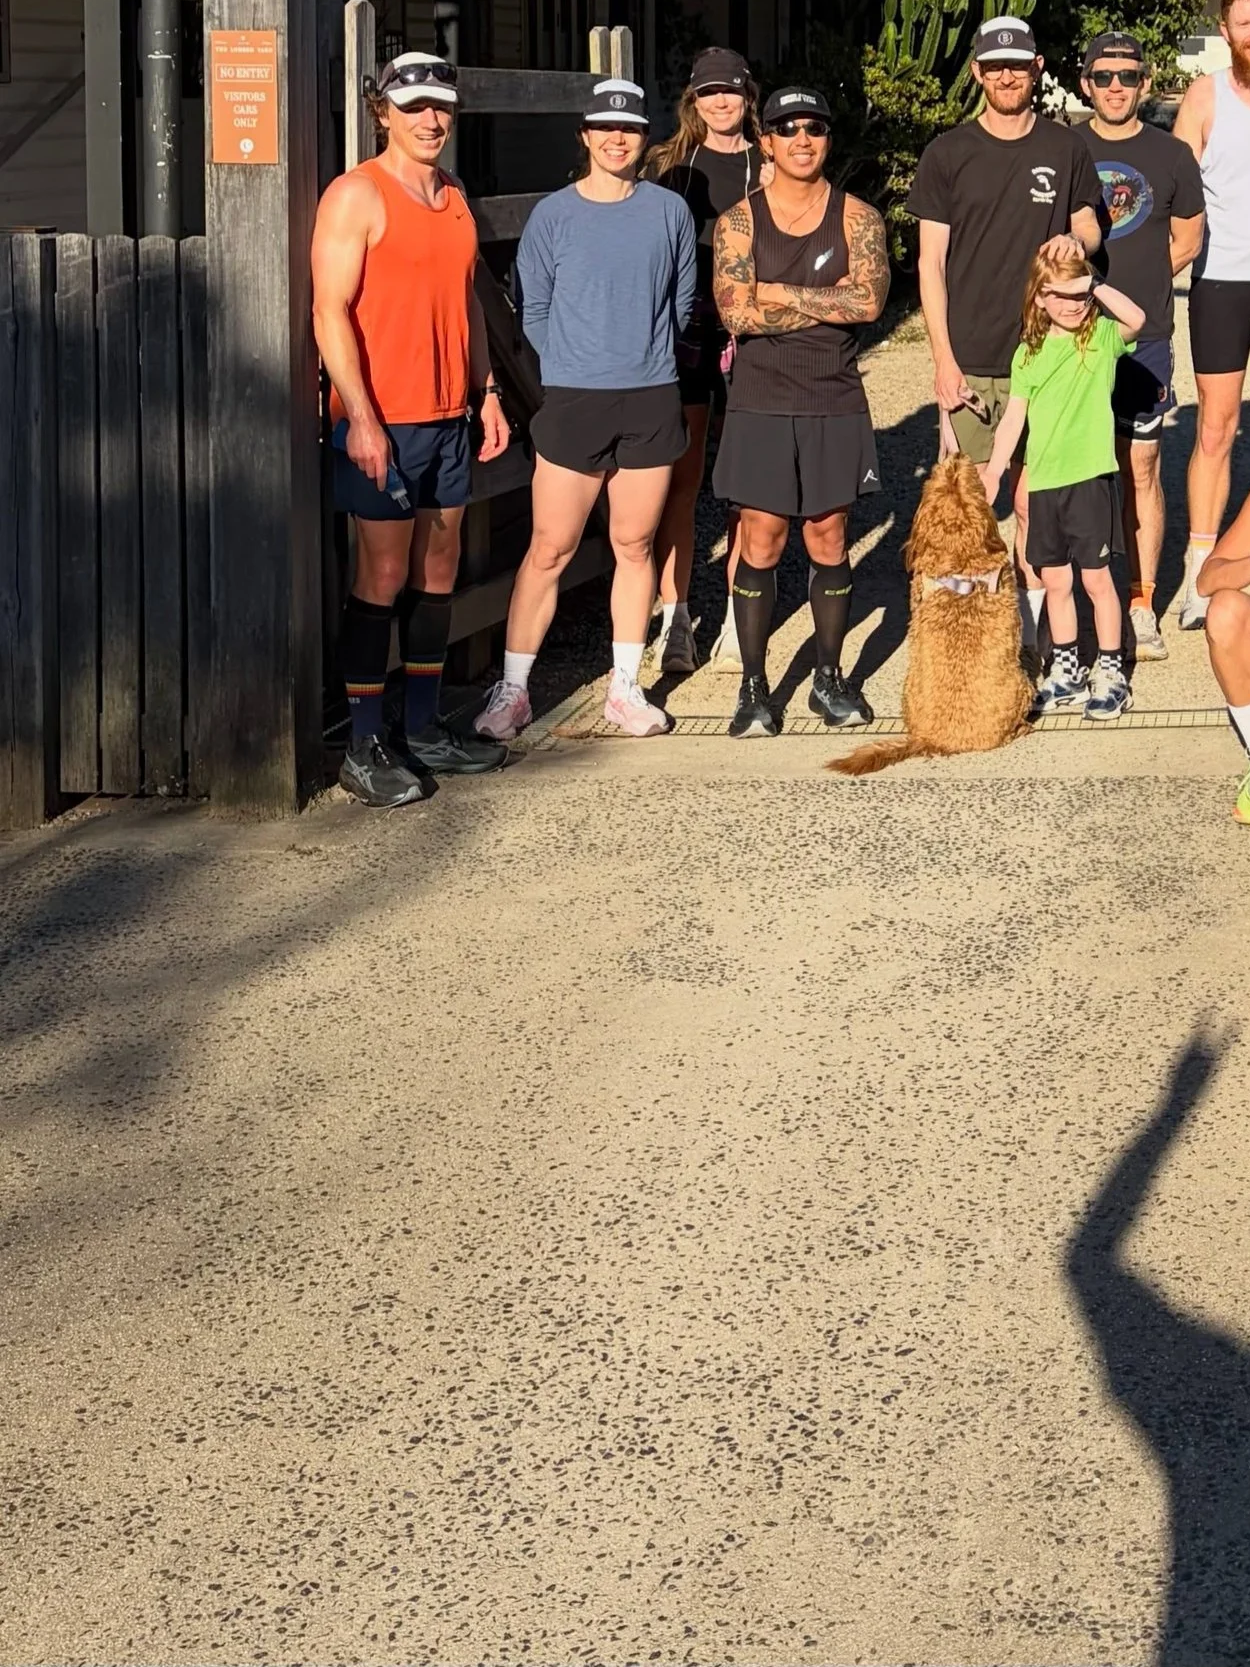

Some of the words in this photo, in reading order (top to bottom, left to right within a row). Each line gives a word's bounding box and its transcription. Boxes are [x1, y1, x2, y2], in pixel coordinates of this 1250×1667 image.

[220, 67, 233, 78] NO
[236, 67, 270, 79] ENTRY
[223, 91, 266, 102] VISITORS
[233, 104, 257, 114] CARS
[233, 117, 258, 128] ONLY
